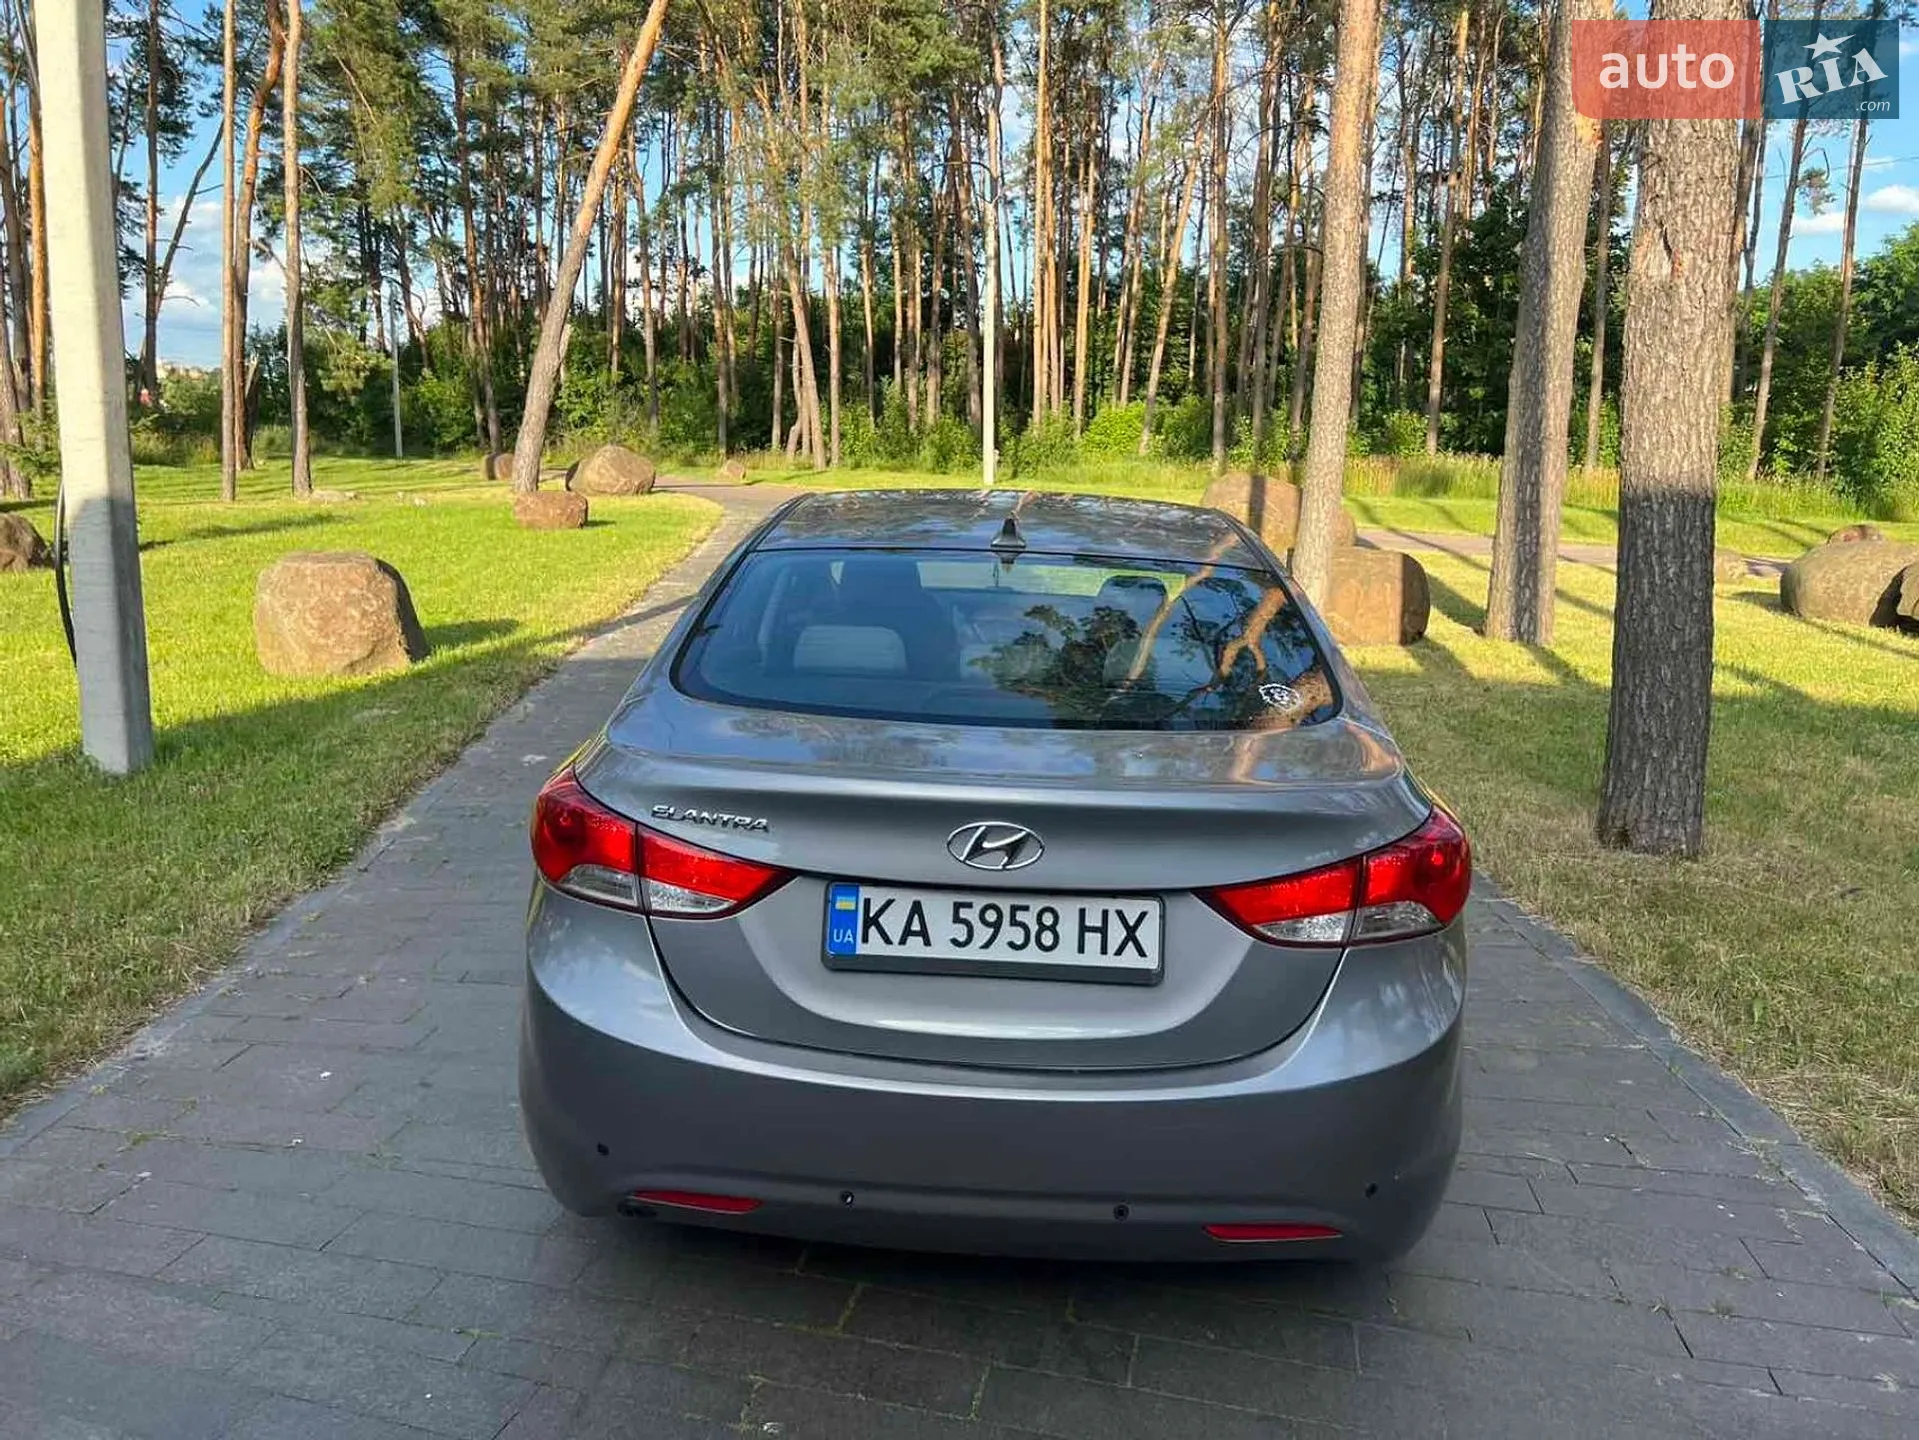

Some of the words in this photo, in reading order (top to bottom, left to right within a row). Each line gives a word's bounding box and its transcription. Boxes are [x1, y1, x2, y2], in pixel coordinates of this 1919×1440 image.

[651, 804, 770, 834] ELANTRA
[833, 928, 855, 944] UA
[860, 897, 932, 947] KA
[949, 901, 1061, 953] 5958
[1076, 907, 1149, 958] HX
